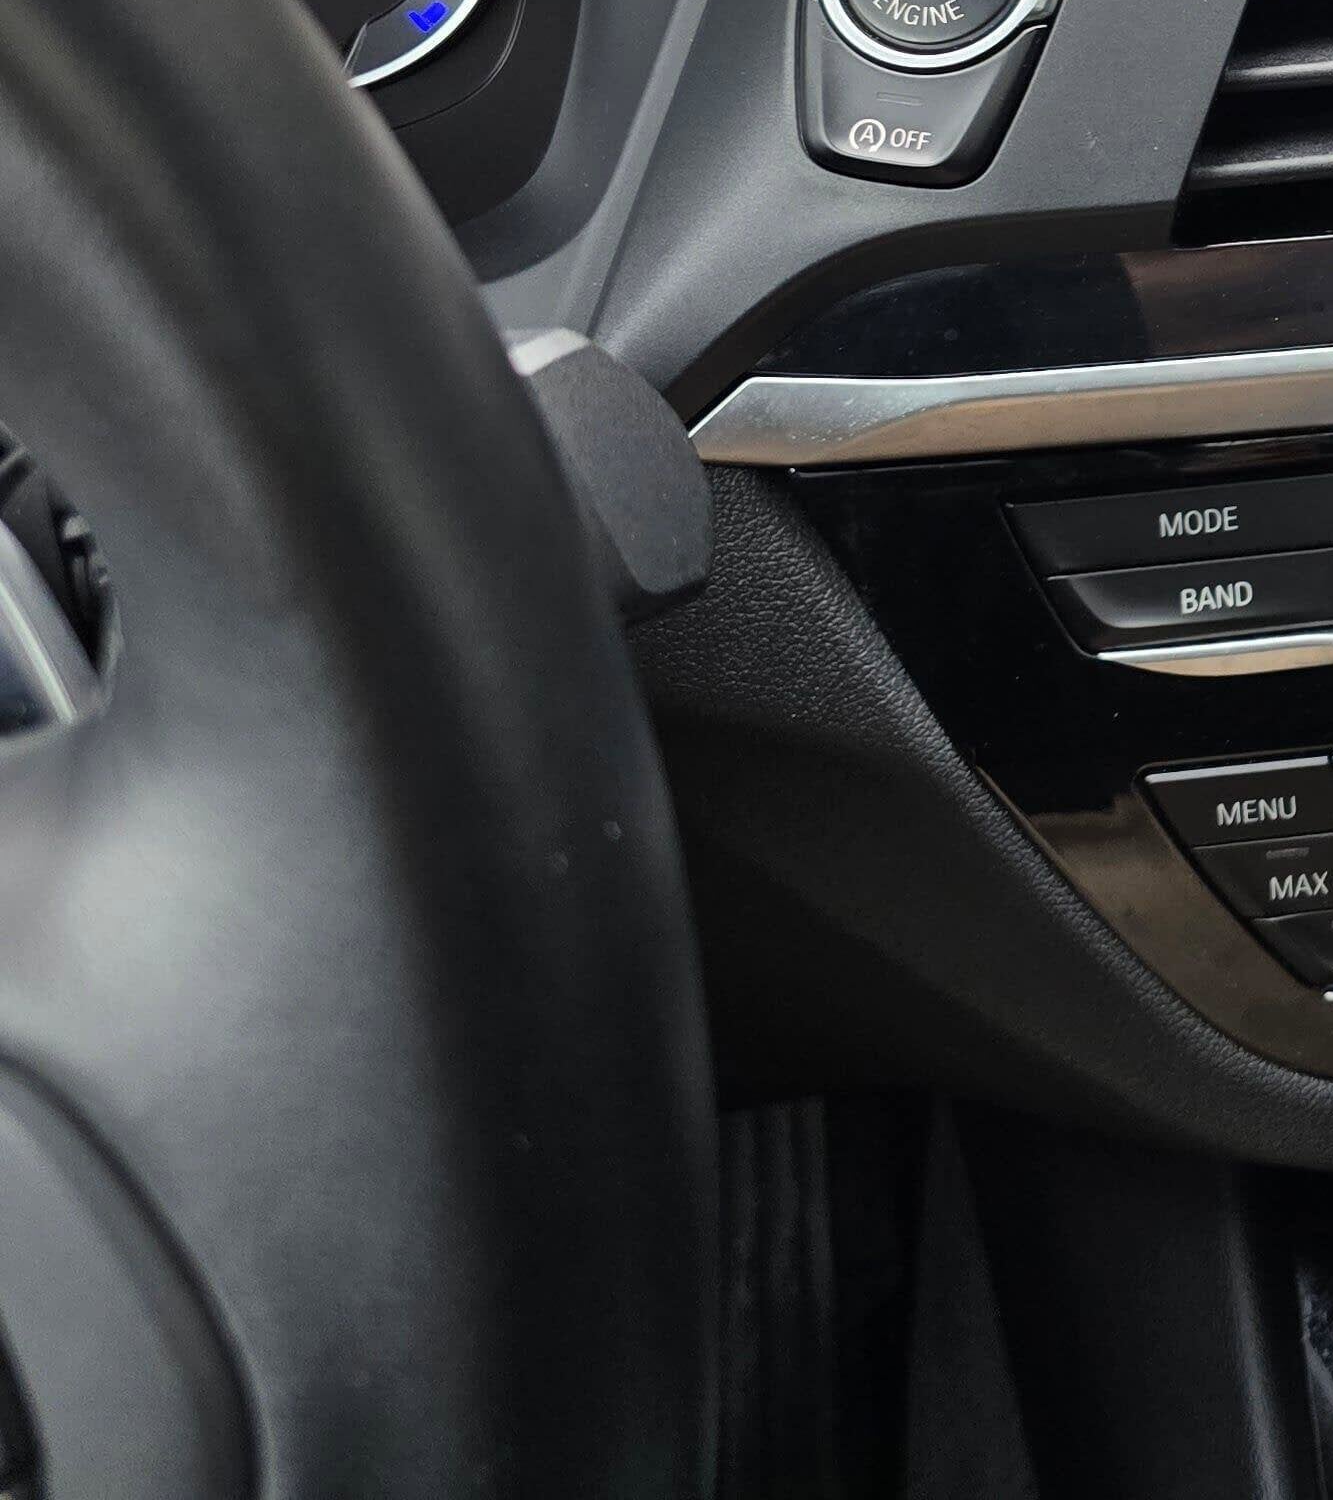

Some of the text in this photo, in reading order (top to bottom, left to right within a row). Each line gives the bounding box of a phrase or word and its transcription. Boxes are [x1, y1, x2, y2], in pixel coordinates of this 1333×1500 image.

[890, 127, 932, 151] OFF
[1158, 505, 1240, 539] MODE
[1180, 580, 1254, 616] BAND
[1215, 795, 1298, 828] MENU
[1268, 870, 1330, 901] MAX
